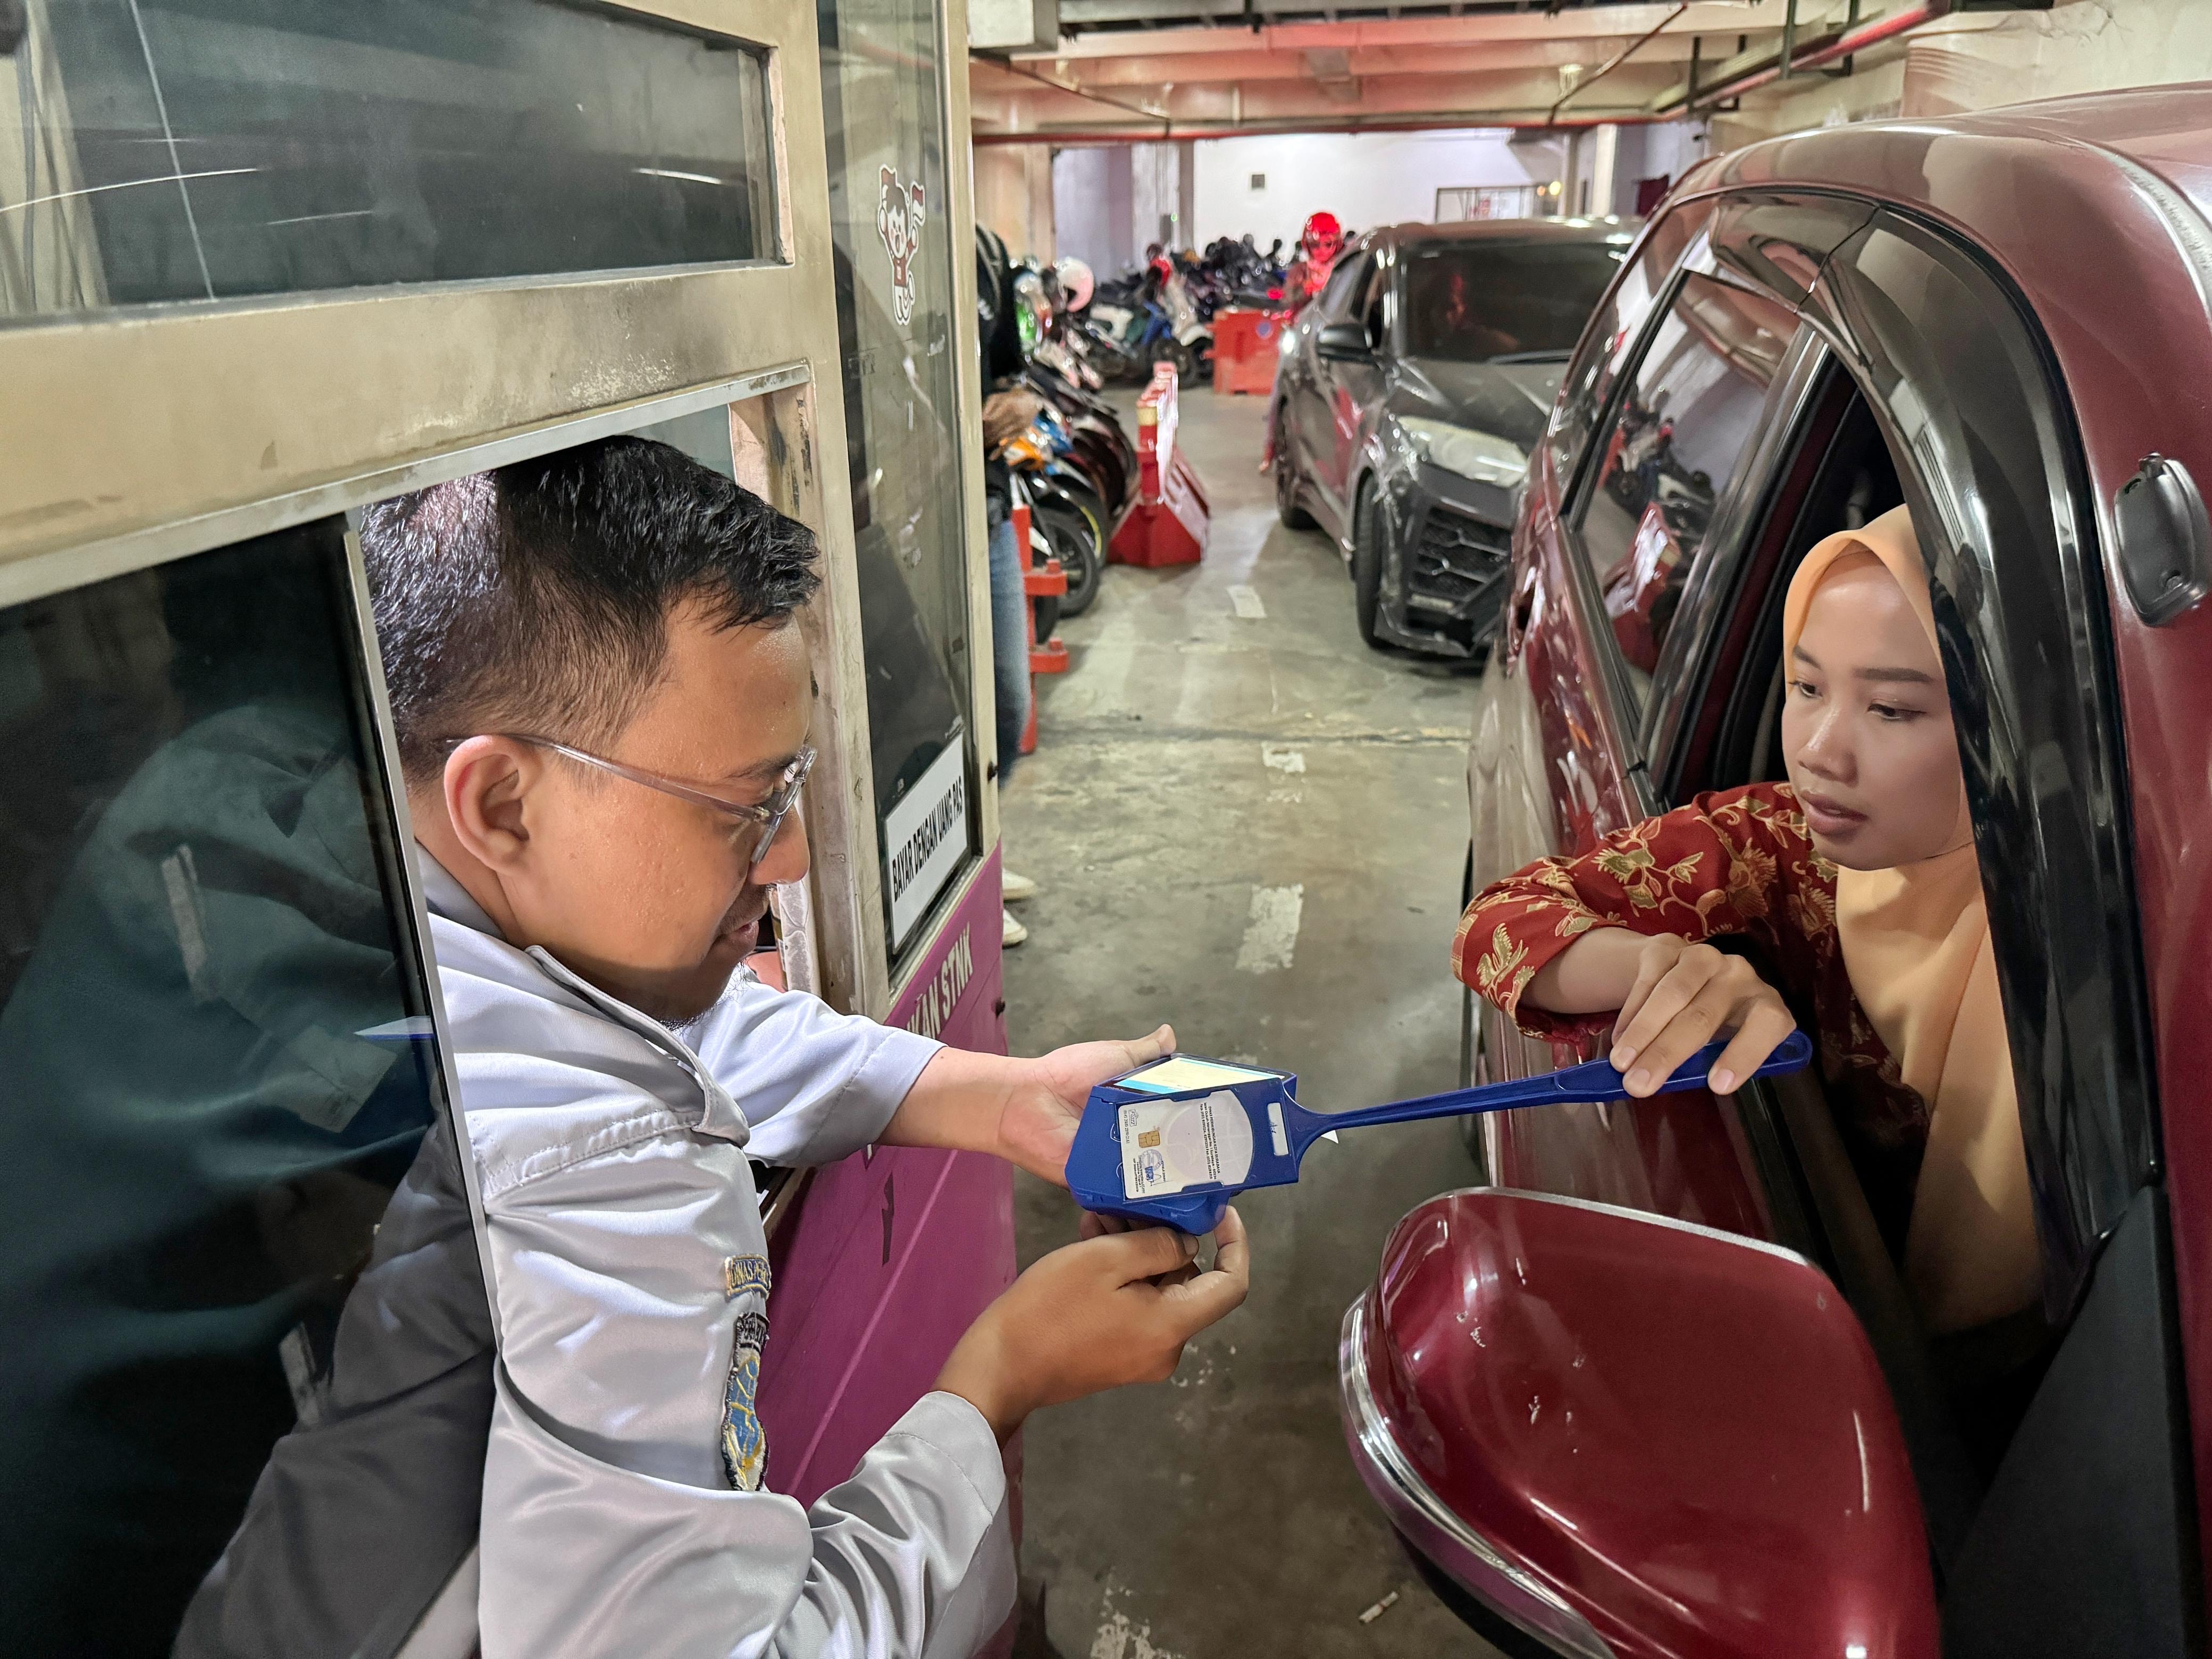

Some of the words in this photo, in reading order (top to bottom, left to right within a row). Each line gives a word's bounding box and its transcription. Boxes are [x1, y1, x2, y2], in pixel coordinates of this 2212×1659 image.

[892, 840, 914, 903] BAYAR
[913, 808, 938, 875] DENGAN
[937, 788, 952, 842] UANG
[953, 775, 963, 823] PAS
[941, 920, 974, 1021] STNK
